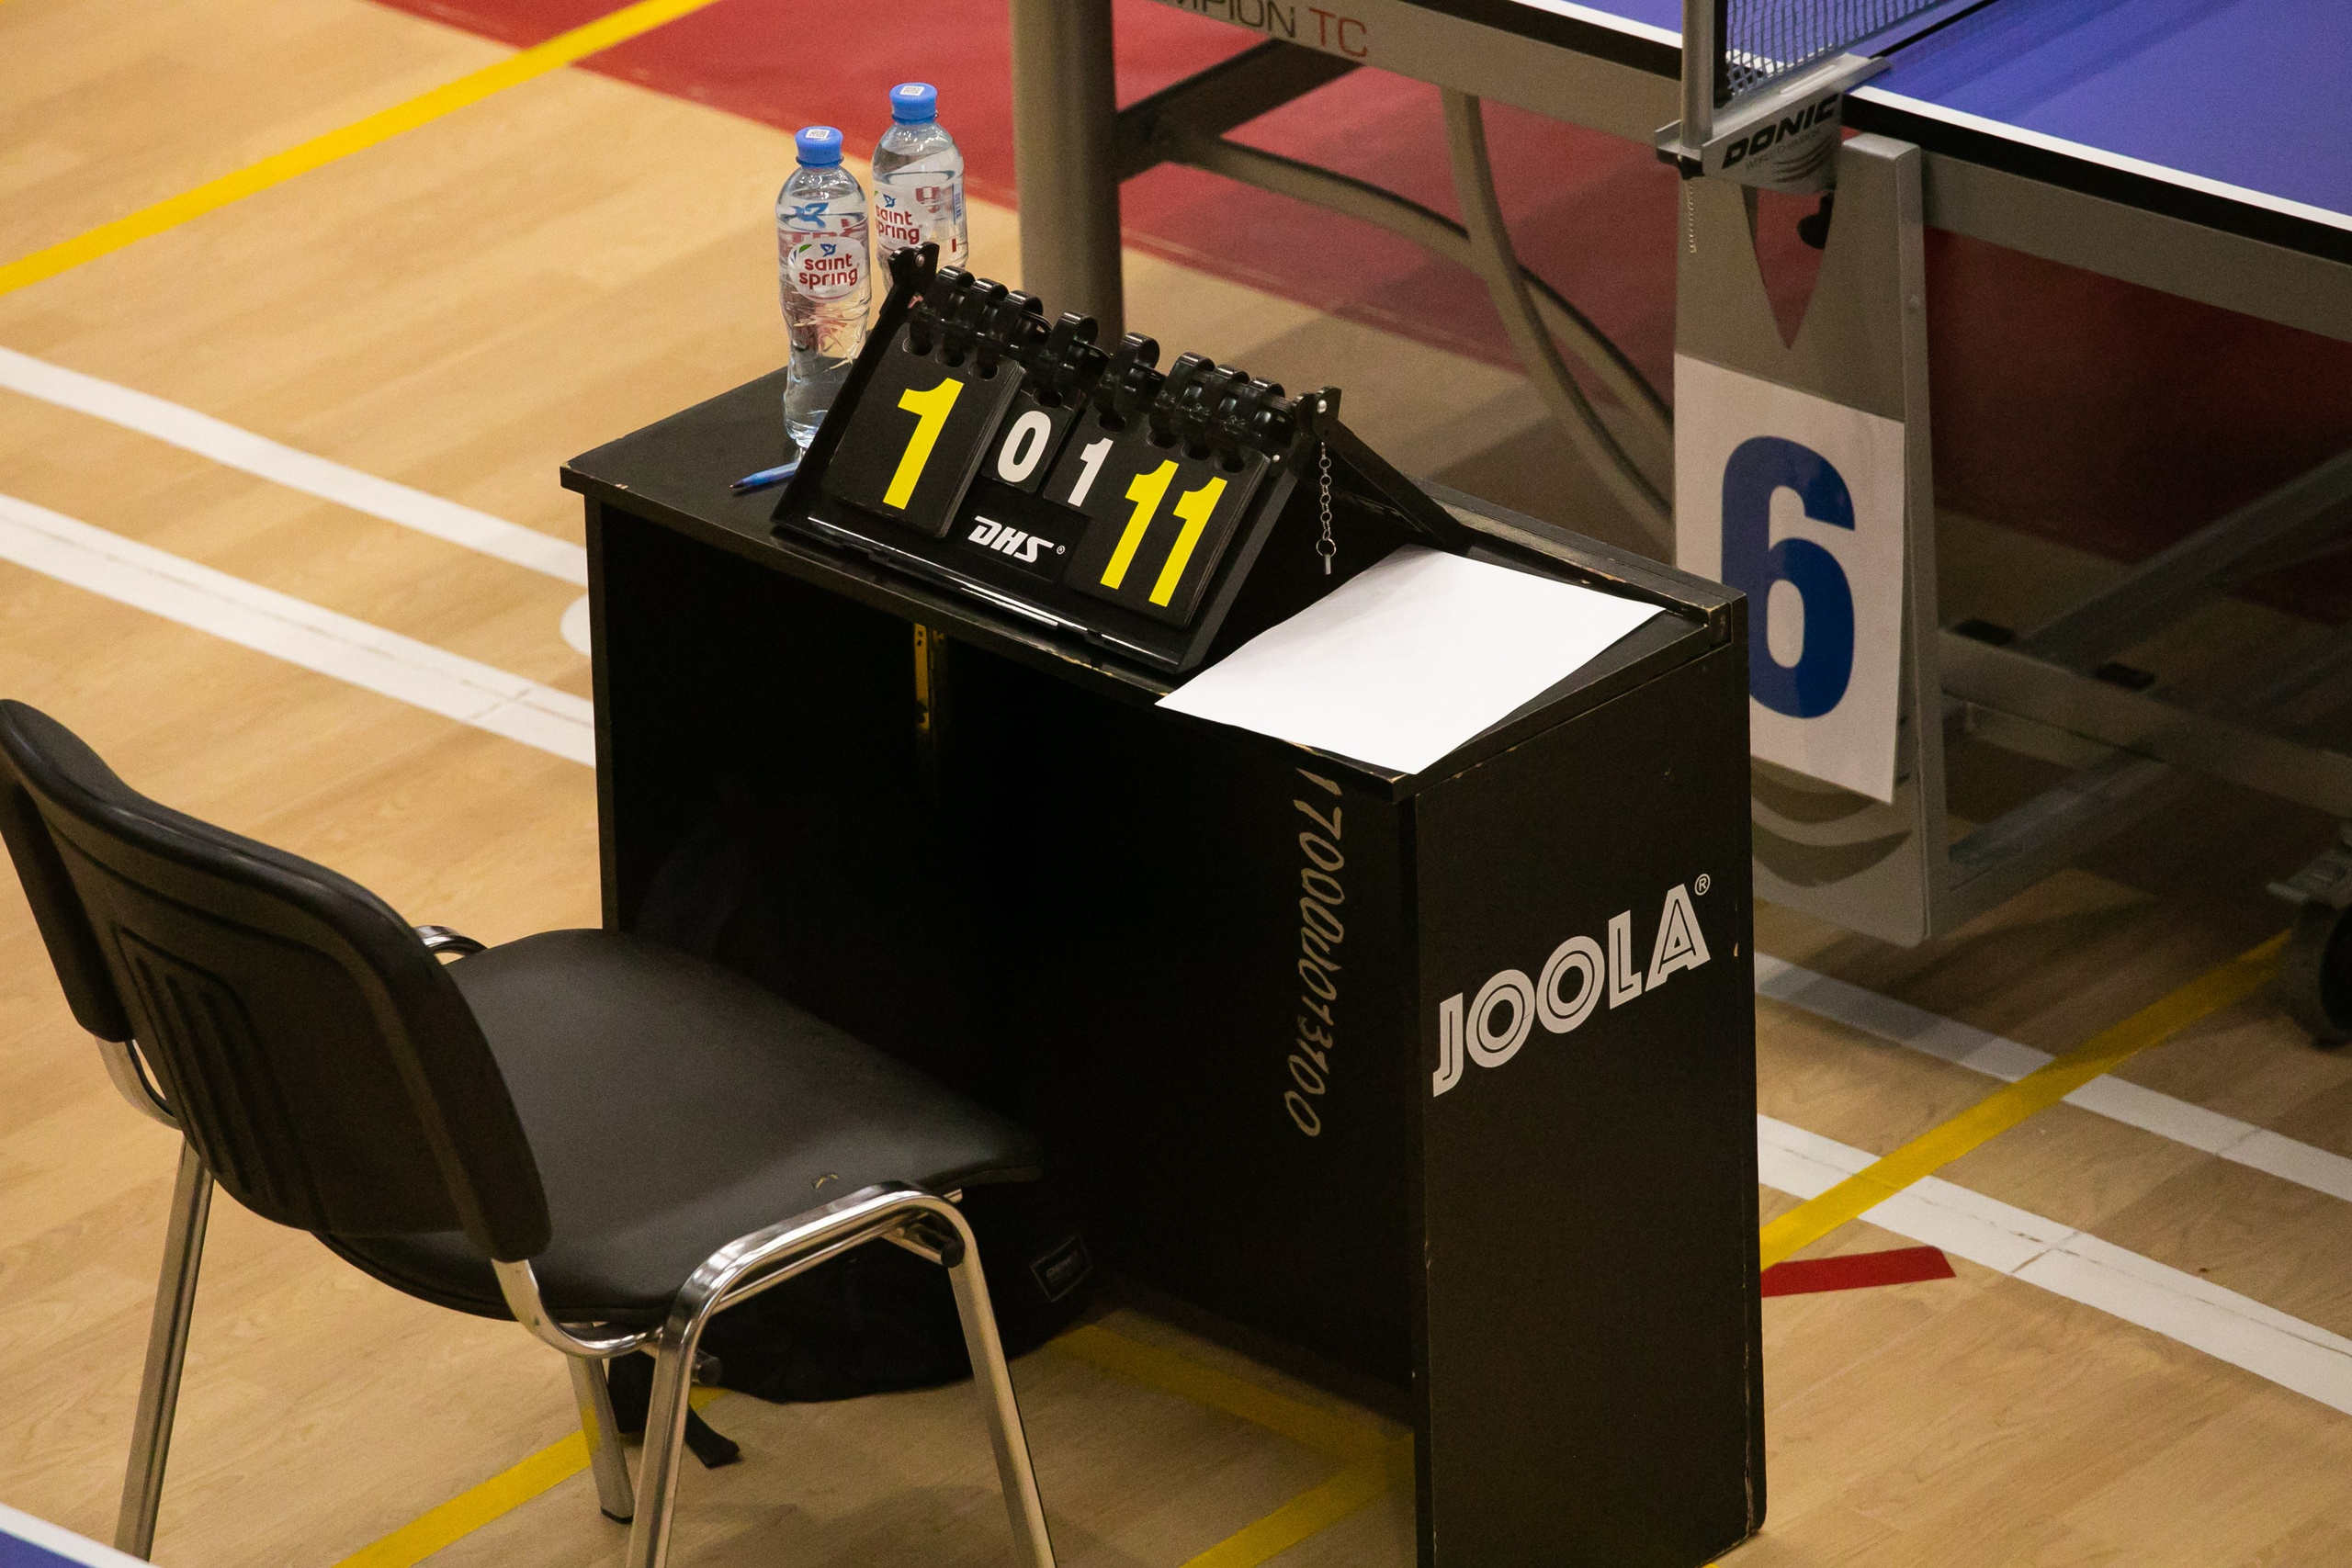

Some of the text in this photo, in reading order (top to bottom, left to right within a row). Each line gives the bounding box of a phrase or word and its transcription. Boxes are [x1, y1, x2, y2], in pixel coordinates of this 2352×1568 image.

[1309, 7, 1368, 57] TC
[1721, 93, 1839, 169] DONIC
[798, 267, 858, 289] spring
[804, 254, 853, 271] saint
[883, 378, 1228, 607] 1 0 1 11
[1721, 434, 1856, 718] 6
